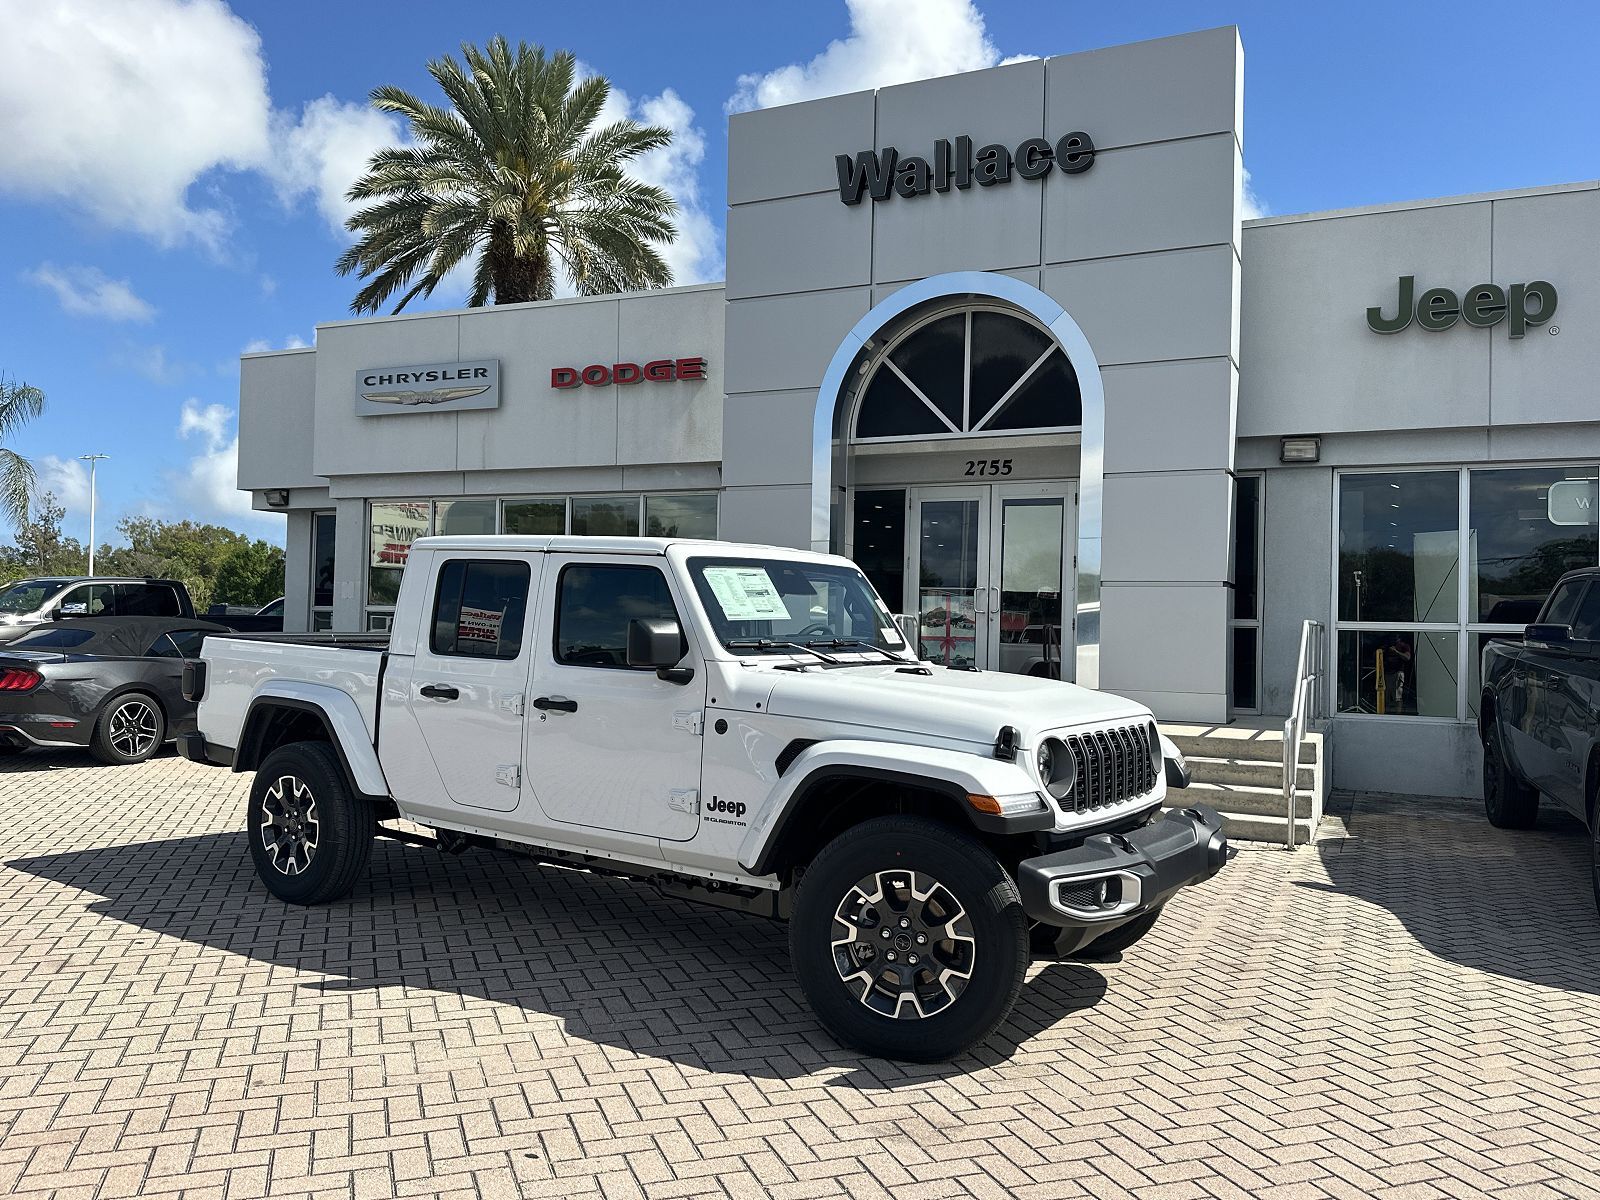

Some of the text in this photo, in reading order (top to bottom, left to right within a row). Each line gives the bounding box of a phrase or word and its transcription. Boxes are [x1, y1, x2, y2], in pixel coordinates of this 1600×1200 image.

[835, 131, 1096, 206] Wallace
[1366, 275, 1559, 339] Jeep
[363, 367, 489, 387] CHRYSLER
[551, 357, 708, 389] DODGE
[964, 458, 1013, 476] 2755
[707, 795, 746, 817] Jeep
[710, 817, 747, 827] GLADIATOR
